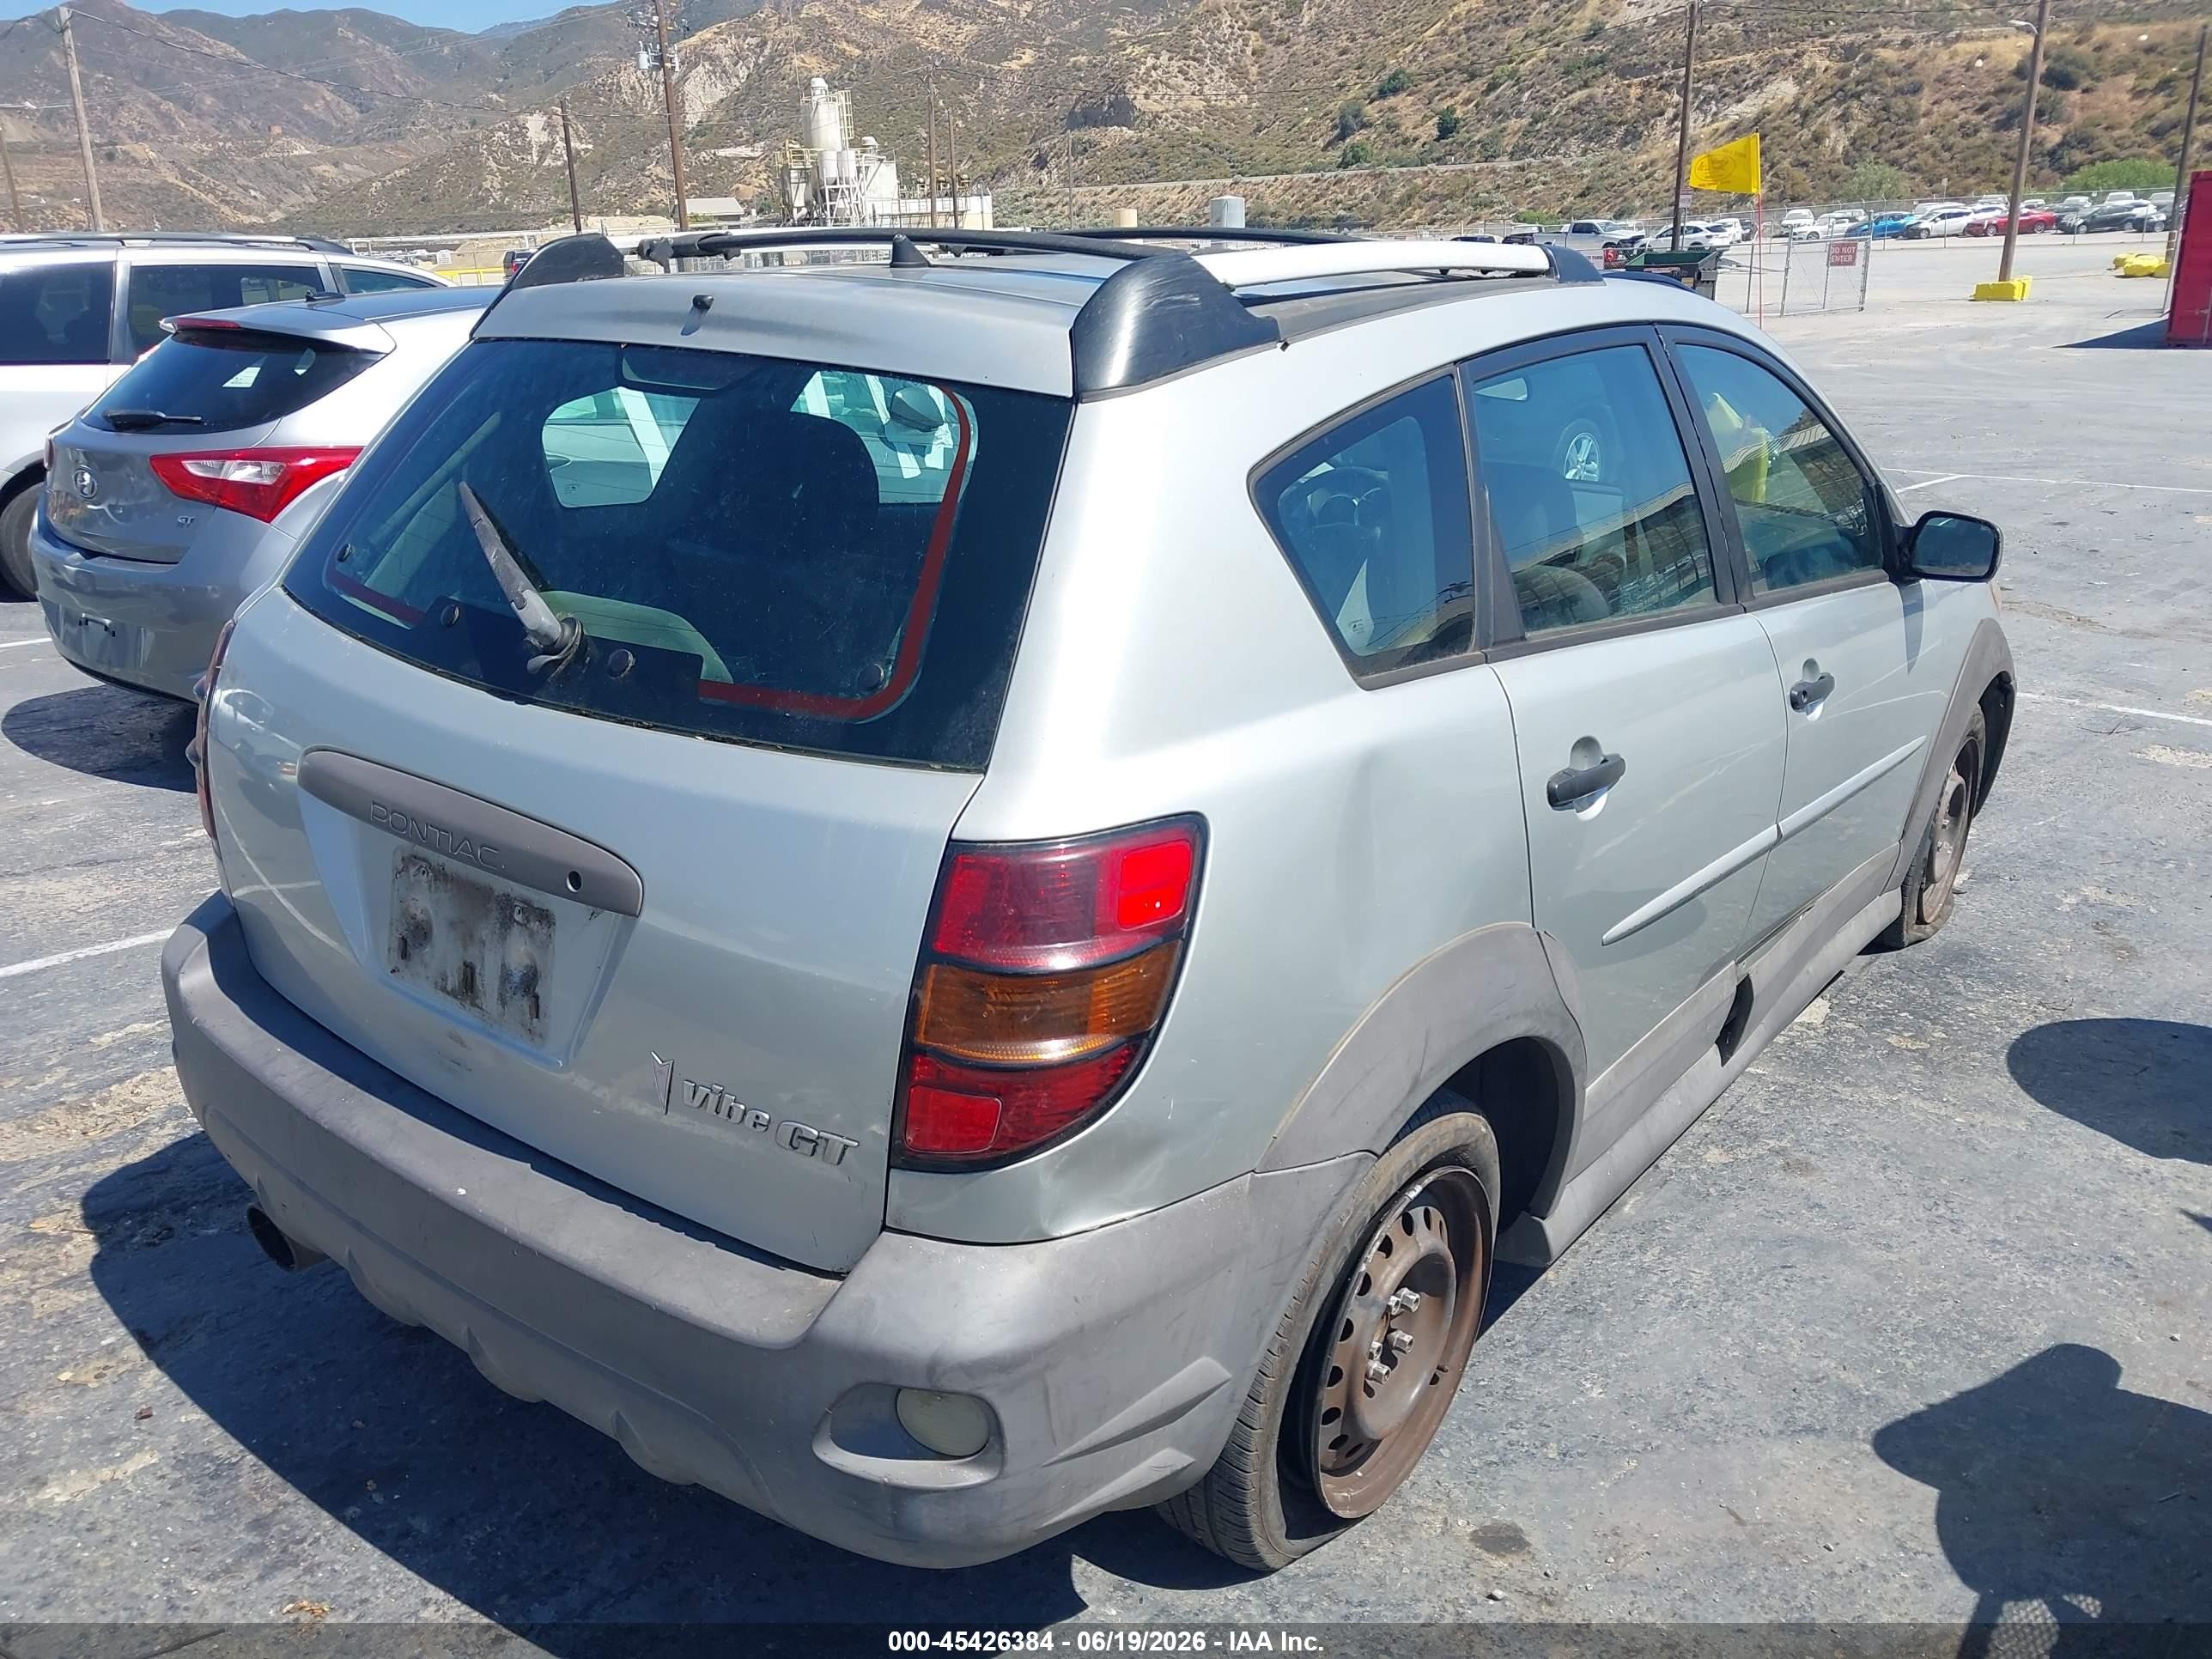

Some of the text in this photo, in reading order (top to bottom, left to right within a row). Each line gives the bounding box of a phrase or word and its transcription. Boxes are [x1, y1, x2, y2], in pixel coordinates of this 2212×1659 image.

[370, 801, 500, 870] PONTIAC
[682, 1079, 860, 1165] vibe GT
